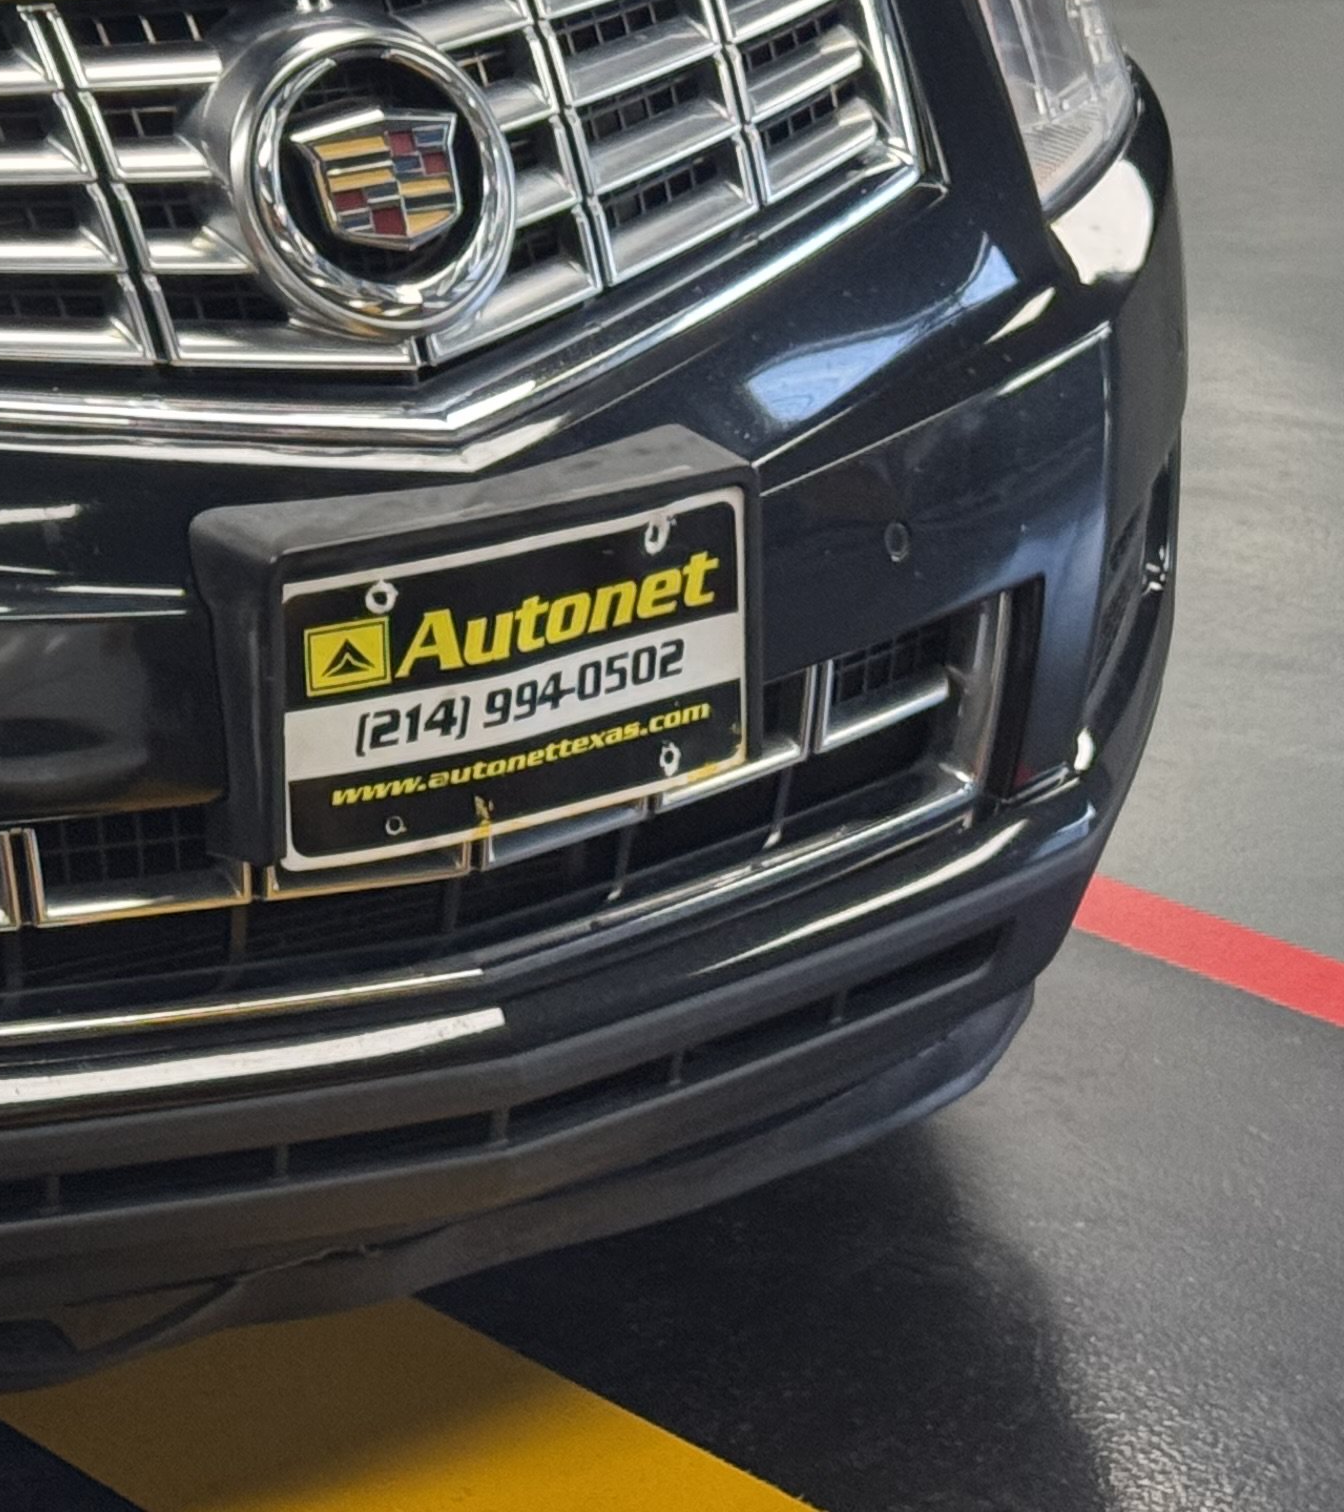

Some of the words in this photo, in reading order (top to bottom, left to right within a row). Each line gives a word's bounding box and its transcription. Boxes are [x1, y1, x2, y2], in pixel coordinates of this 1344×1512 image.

[395, 551, 719, 678] Autonet
[331, 702, 711, 807] www.autonettexas.com
[356, 695, 471, 757] (214)
[483, 638, 685, 729] 994-0502
